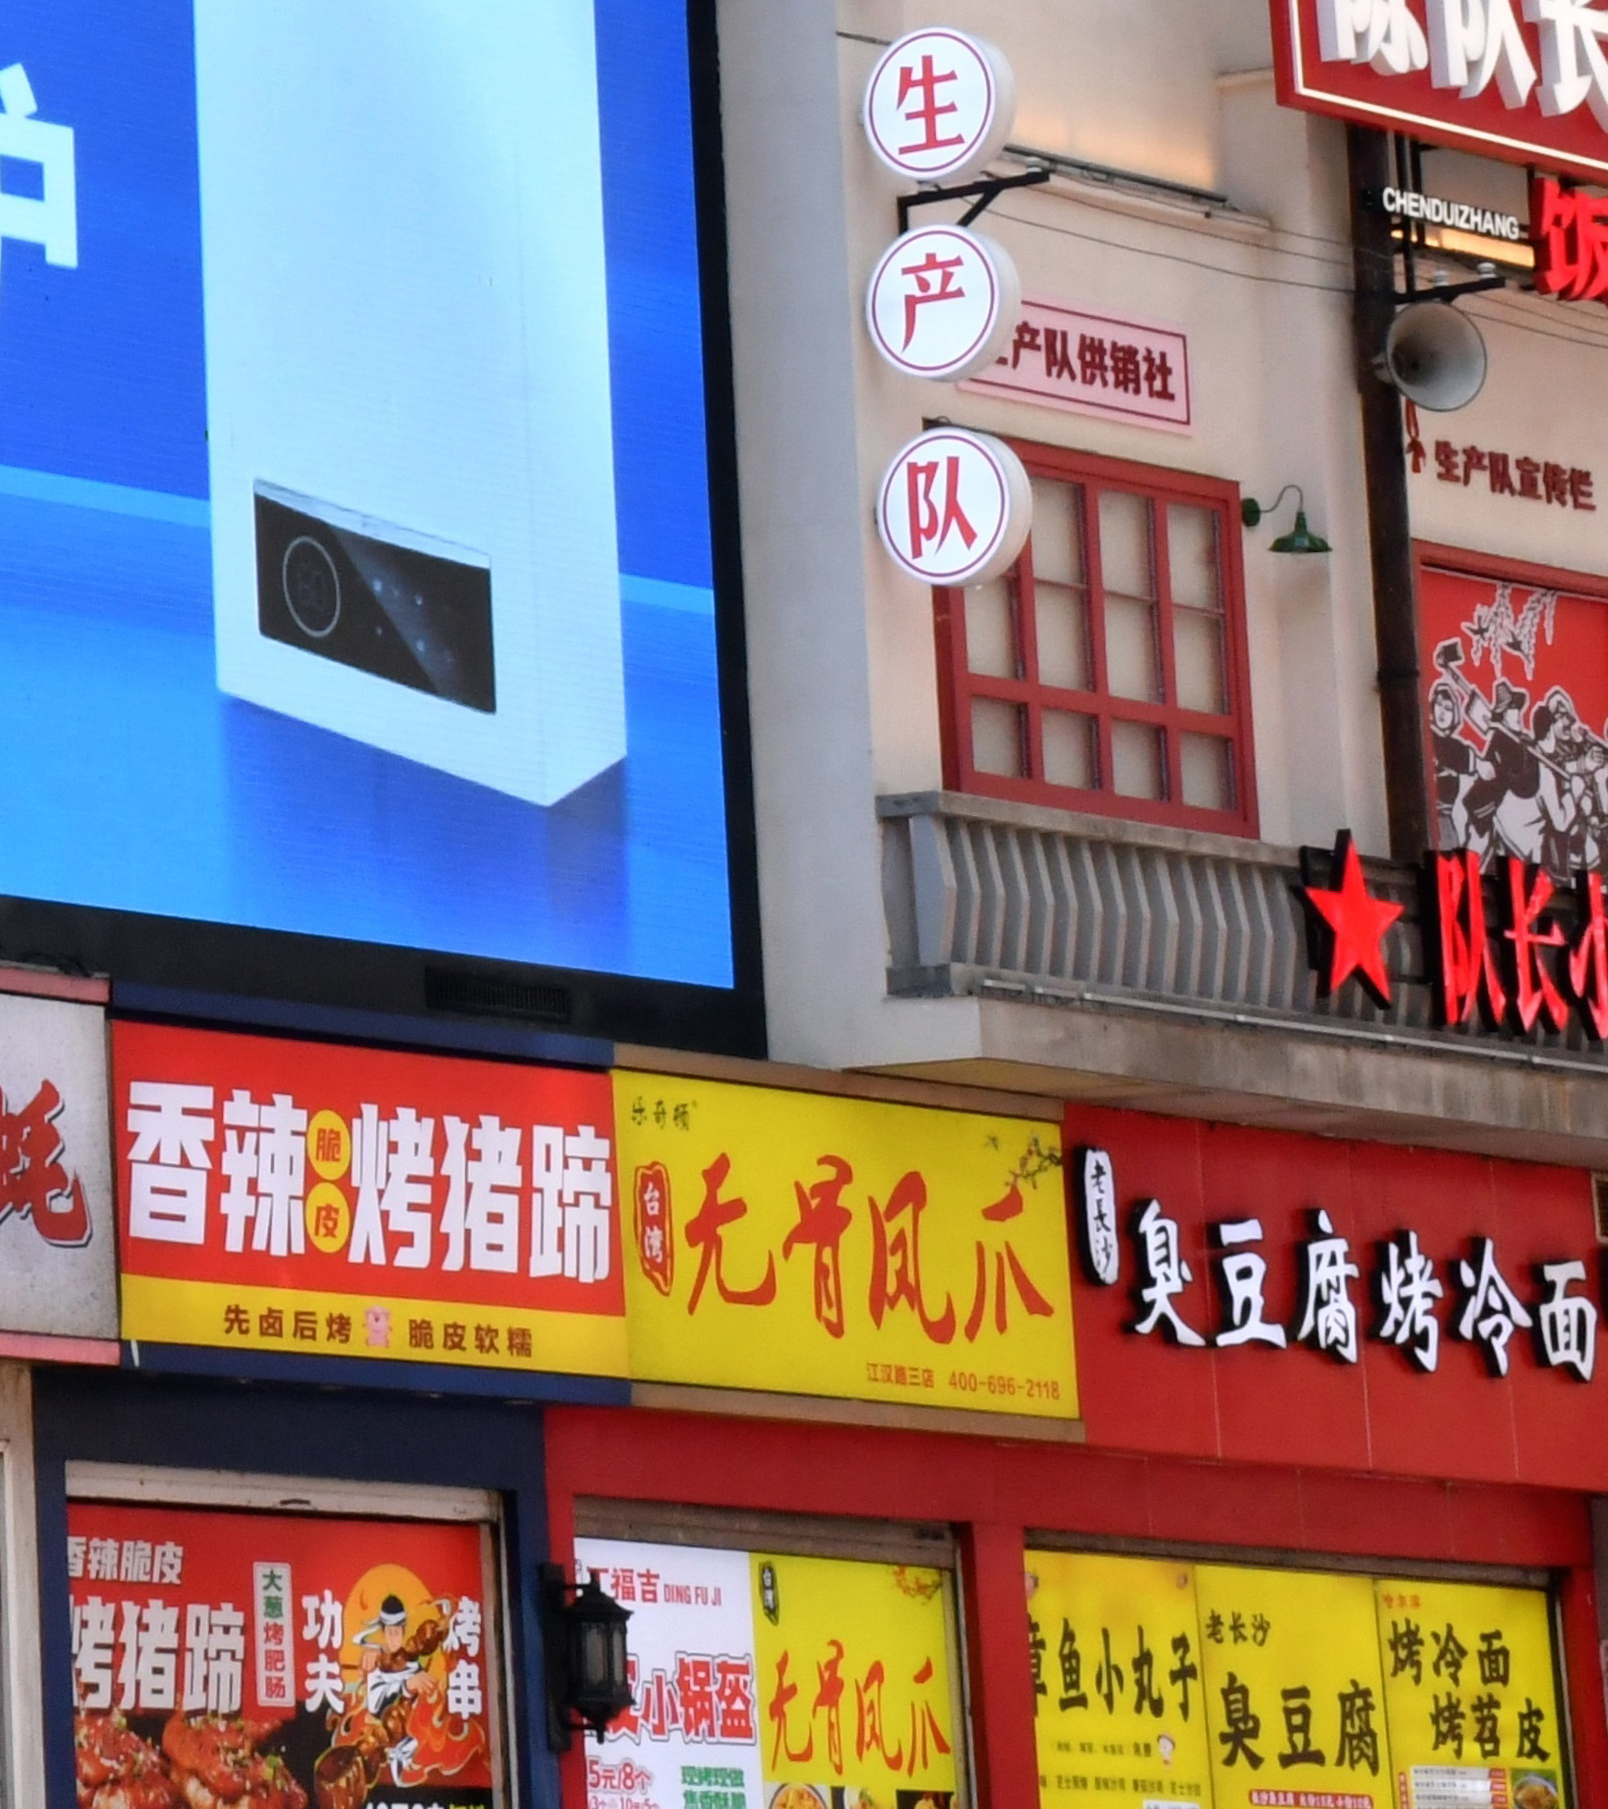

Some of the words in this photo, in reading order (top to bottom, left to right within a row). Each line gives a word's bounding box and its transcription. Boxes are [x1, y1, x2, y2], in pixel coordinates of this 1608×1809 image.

[1382, 187, 1520, 240] CHENDUIZHANG
[996, 321, 1176, 402] 产队供销社
[1434, 439, 1596, 511] 生产队宣传栏
[127, 1080, 309, 1257] 香辣
[314, 1127, 342, 1240] 脆皮
[348, 1102, 612, 1283] 烤猪蹄
[643, 1181, 664, 1263] 台湾
[684, 1152, 1055, 1345] 无骨凤爪
[1134, 1198, 1598, 1382] 臭豆腐烤冷面
[224, 1304, 352, 1344] 先卤后烤
[408, 1318, 534, 1358] 脆皮软糯
[948, 1370, 1061, 1400] 400-696-2118
[67, 1536, 184, 1584] 香辣脆皮
[663, 1583, 692, 1605] DING
[695, 1585, 708, 1606] FU
[69, 1594, 245, 1714] 烤猪蹄
[262, 1569, 287, 1699] 大葱烤肥肠
[1205, 1609, 1271, 1647] 老长沙
[1387, 1617, 1510, 1688] 烤冷面
[770, 1639, 952, 1778] 无骨凤爪
[1218, 1671, 1380, 1777] 臭豆腐
[1429, 1691, 1551, 1763] 烤苕皮
